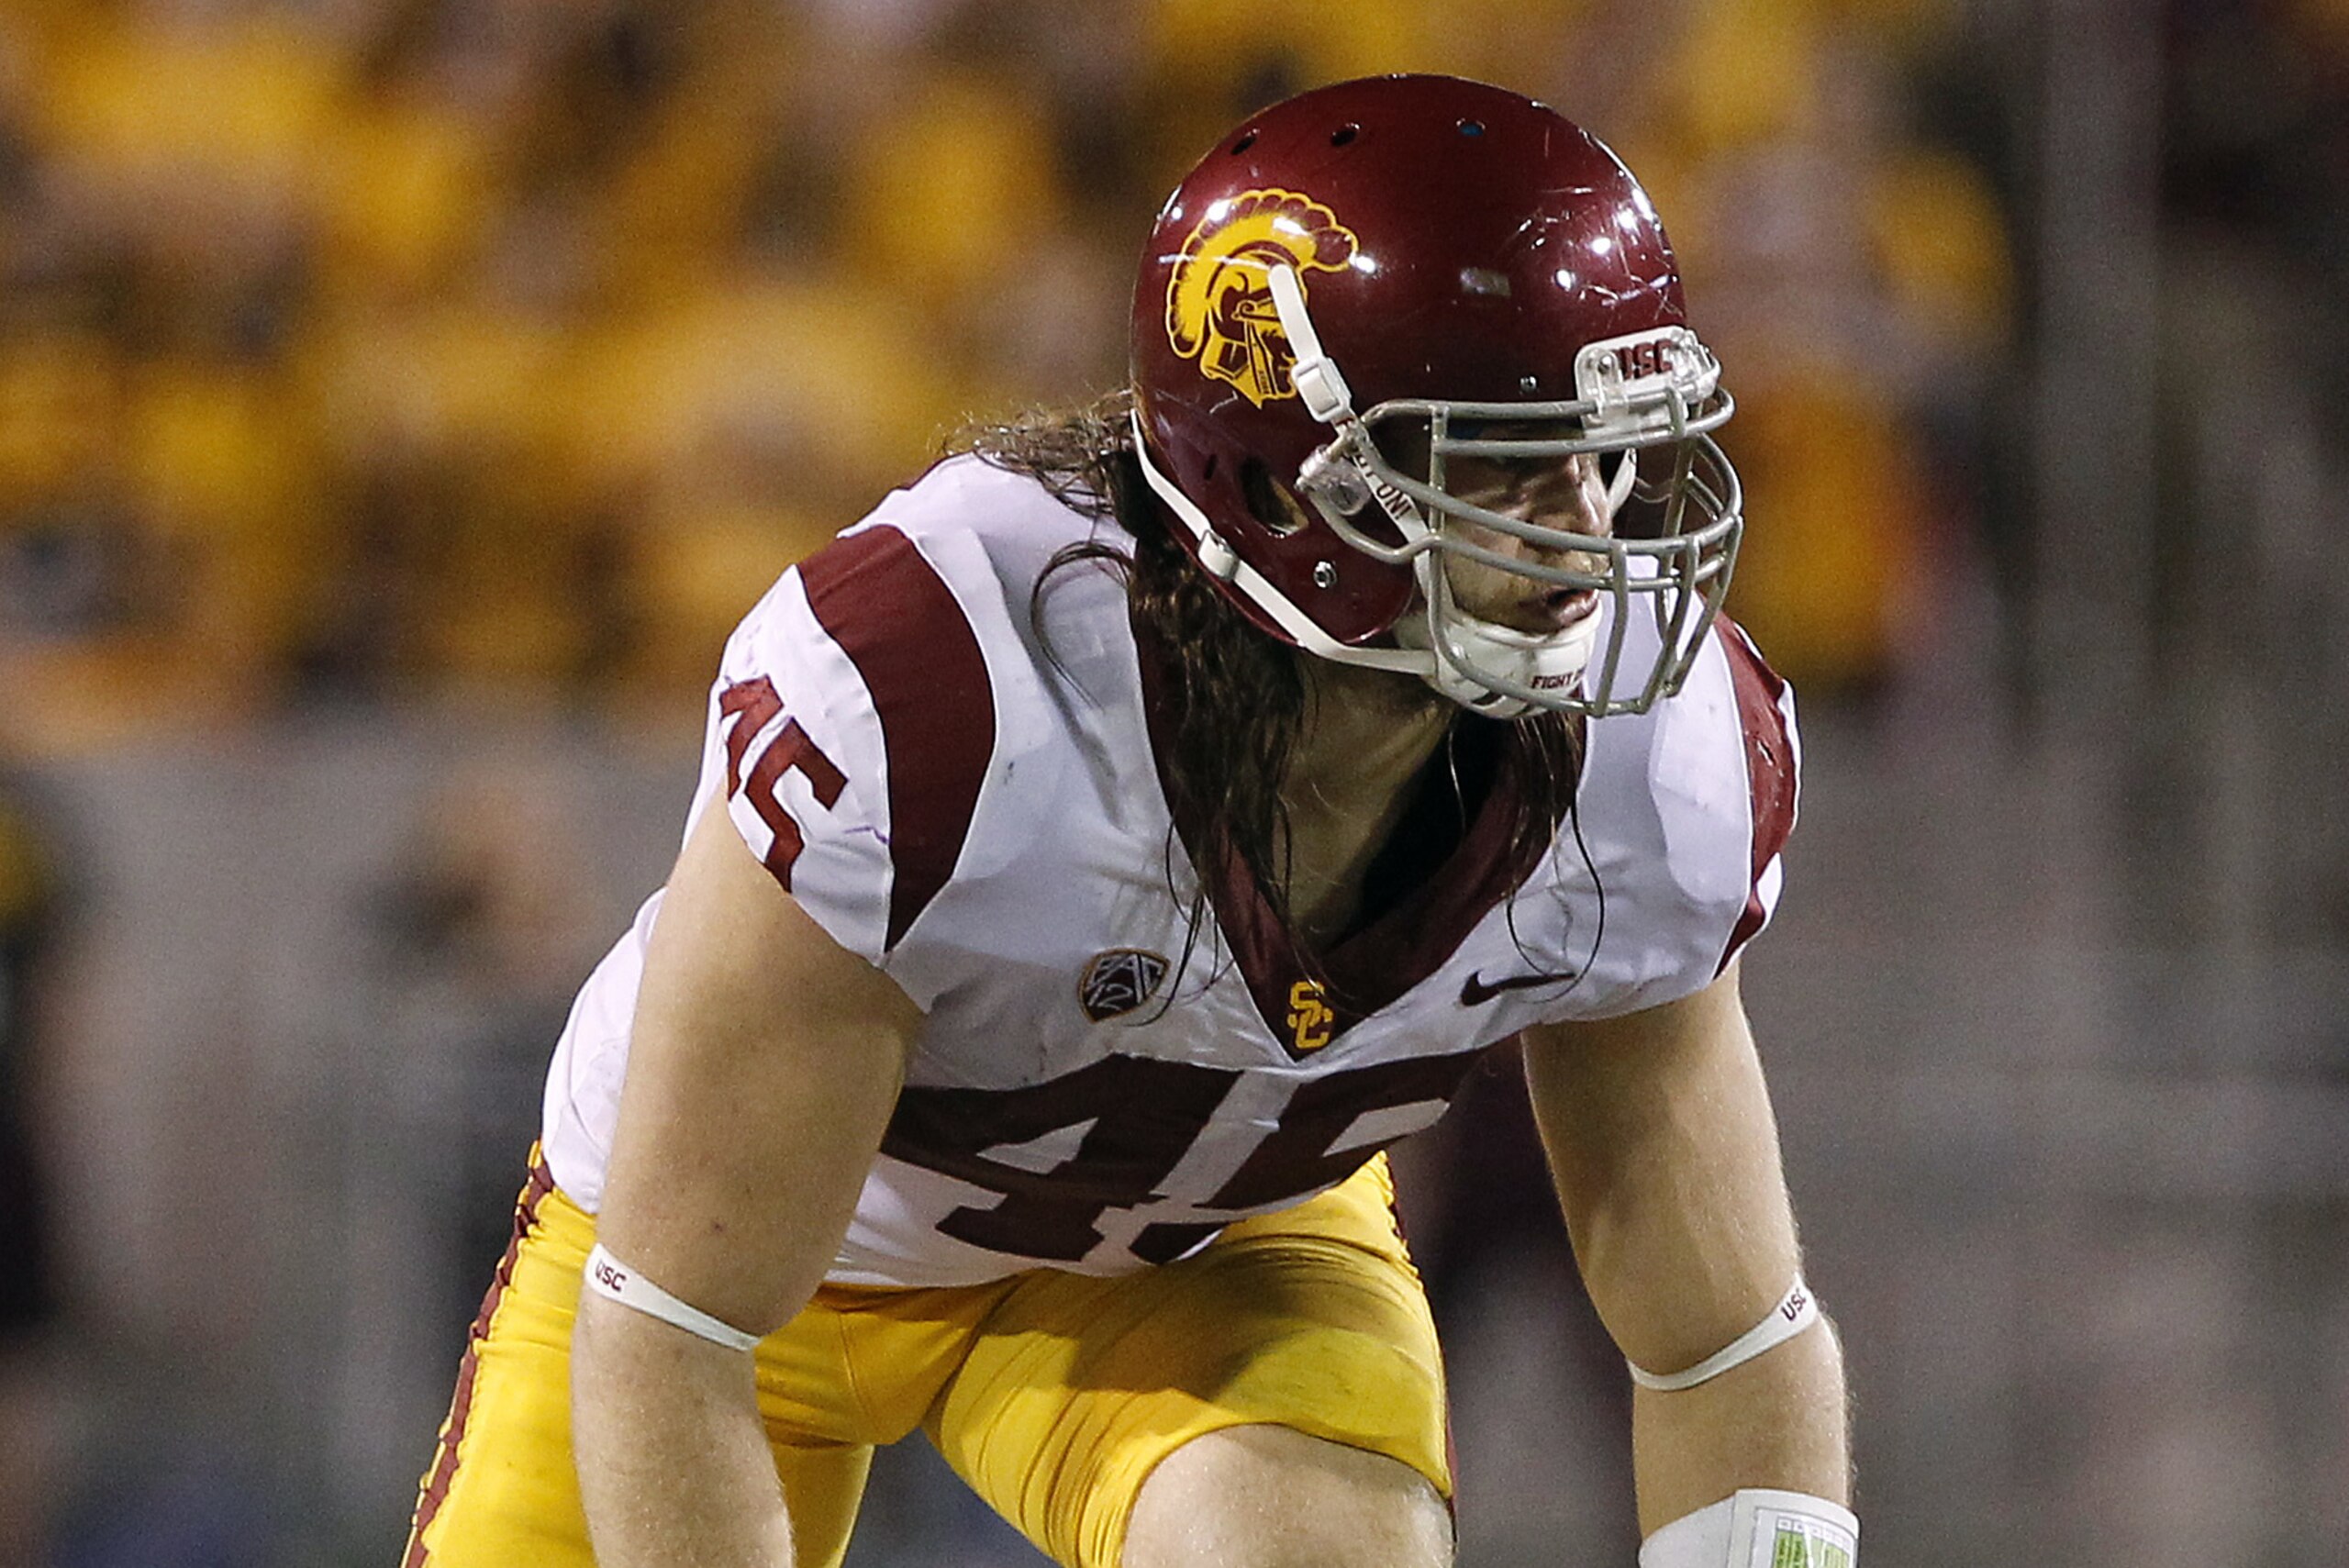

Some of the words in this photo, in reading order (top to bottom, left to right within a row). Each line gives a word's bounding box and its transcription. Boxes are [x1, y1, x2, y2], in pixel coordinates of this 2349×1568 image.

[1531, 672, 1574, 690] FIGHT
[1287, 981, 1333, 1049] SC
[882, 1052, 1479, 1263] 45
[596, 1259, 626, 1292] USC
[1781, 1288, 1806, 1321] USC
